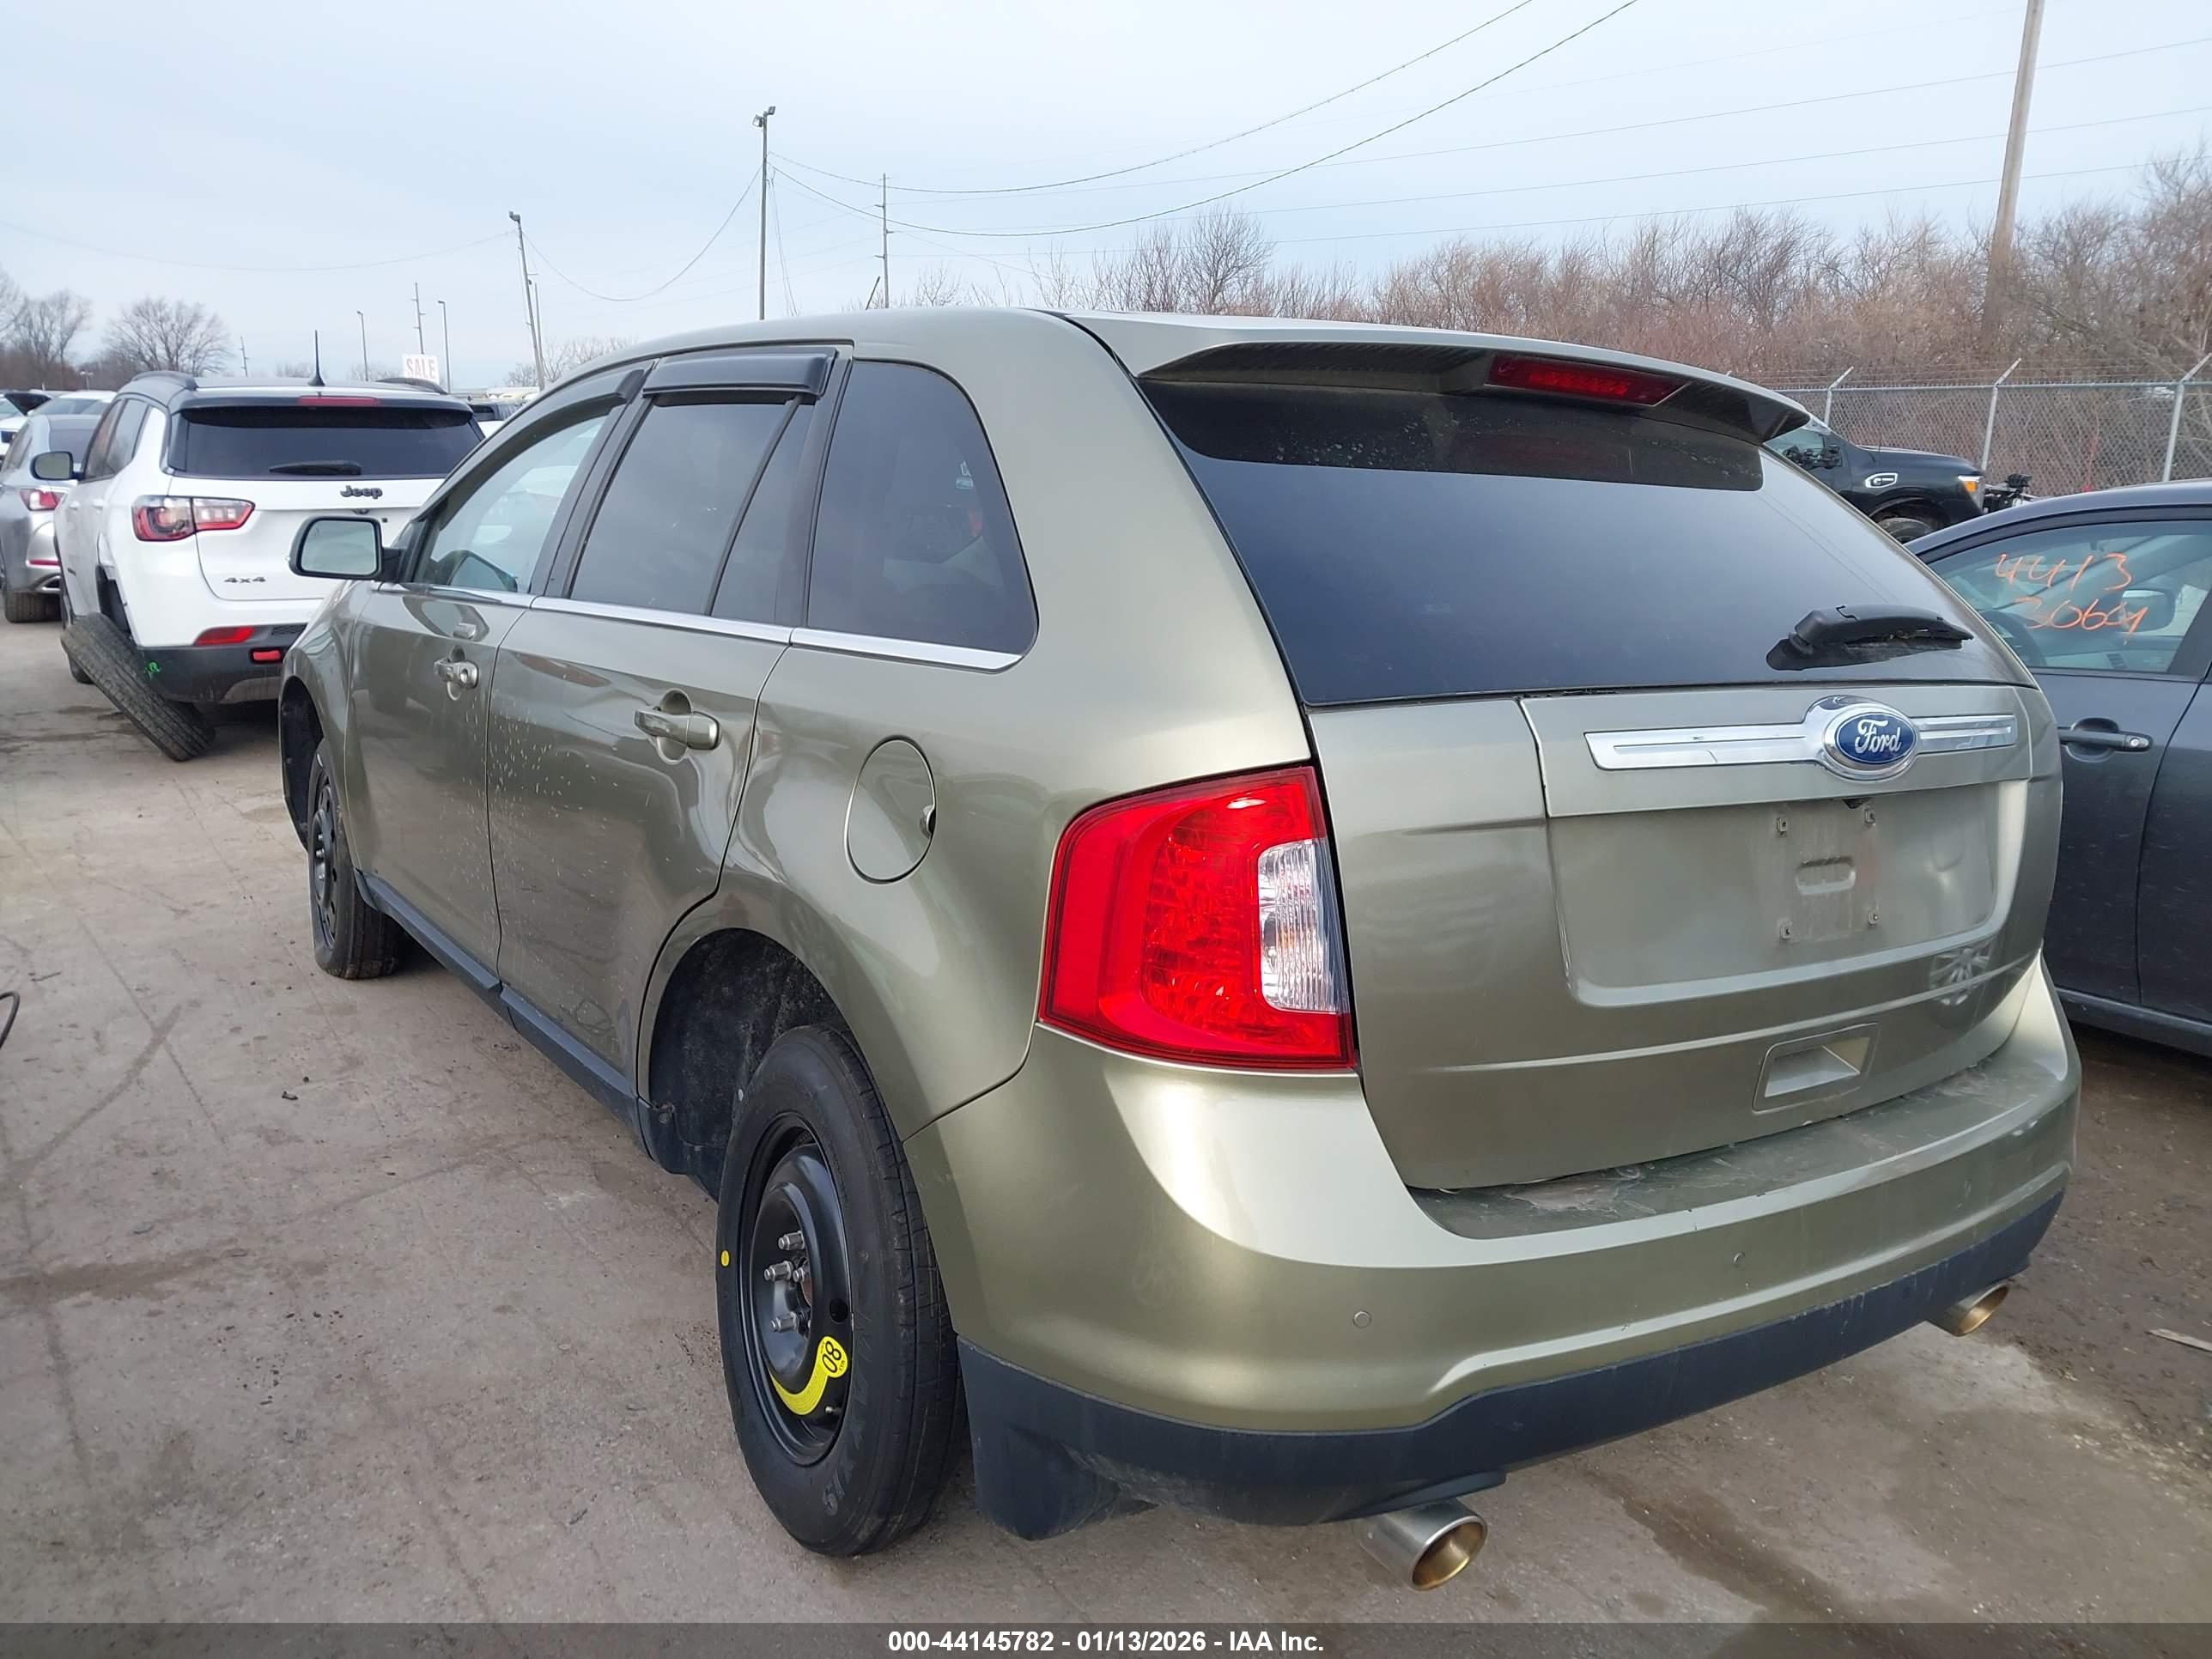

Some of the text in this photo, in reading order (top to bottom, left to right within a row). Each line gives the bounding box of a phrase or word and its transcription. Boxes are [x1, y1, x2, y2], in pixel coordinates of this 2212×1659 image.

[405, 357, 436, 380] SALE
[340, 484, 383, 500] Jeep
[1995, 551, 2132, 593] 4413
[1854, 719, 1903, 754] Ford
[822, 1340, 842, 1373] 80
